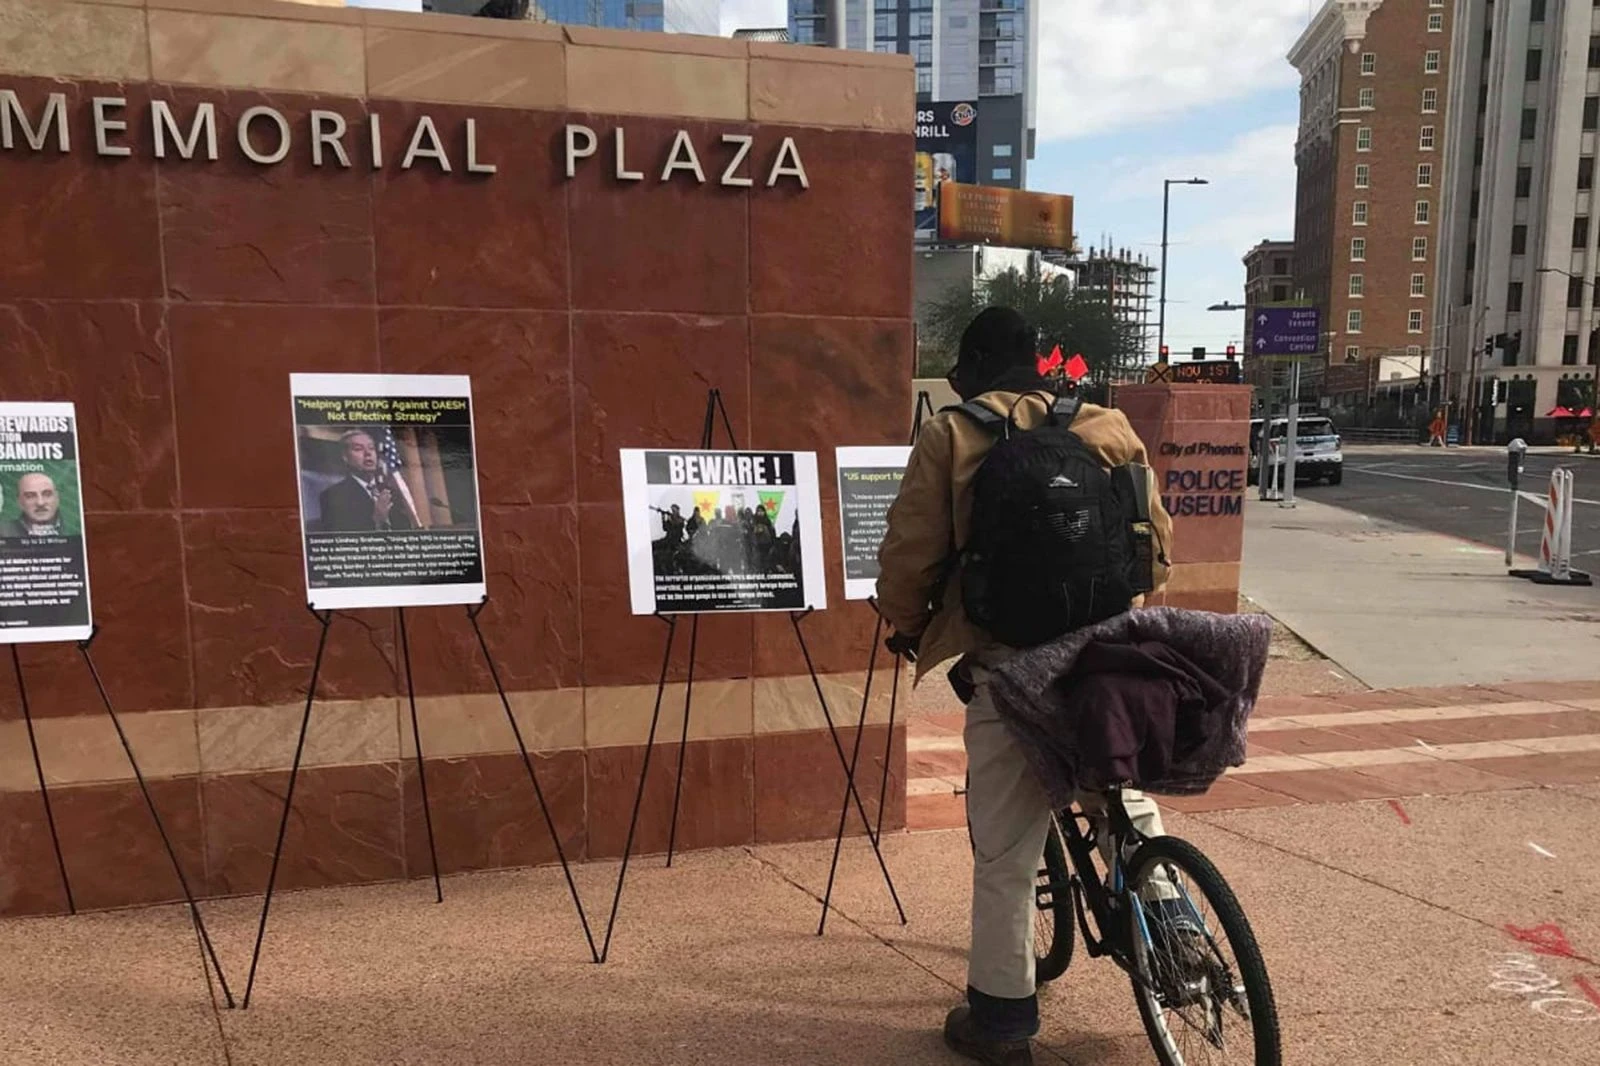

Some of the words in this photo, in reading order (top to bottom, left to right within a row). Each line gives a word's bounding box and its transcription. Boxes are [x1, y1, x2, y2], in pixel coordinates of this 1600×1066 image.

[0, 89, 497, 173] MEMORIAL
[565, 124, 810, 189] PLAZA
[1274, 334, 1316, 343] Convention
[392, 400, 430, 411] Against
[431, 401, 467, 410] DAESH
[0, 416, 69, 432] REWARDS
[327, 411, 347, 421] Not
[349, 411, 393, 421] Effective
[0, 442, 63, 460] BANDITS
[1160, 442, 1184, 458] City
[1184, 442, 1198, 456] of
[1199, 442, 1245, 457] Phoenix
[669, 454, 767, 486] BEWARE
[773, 455, 783, 484] !
[860, 473, 891, 483] support
[1165, 469, 1244, 491] POLICE
